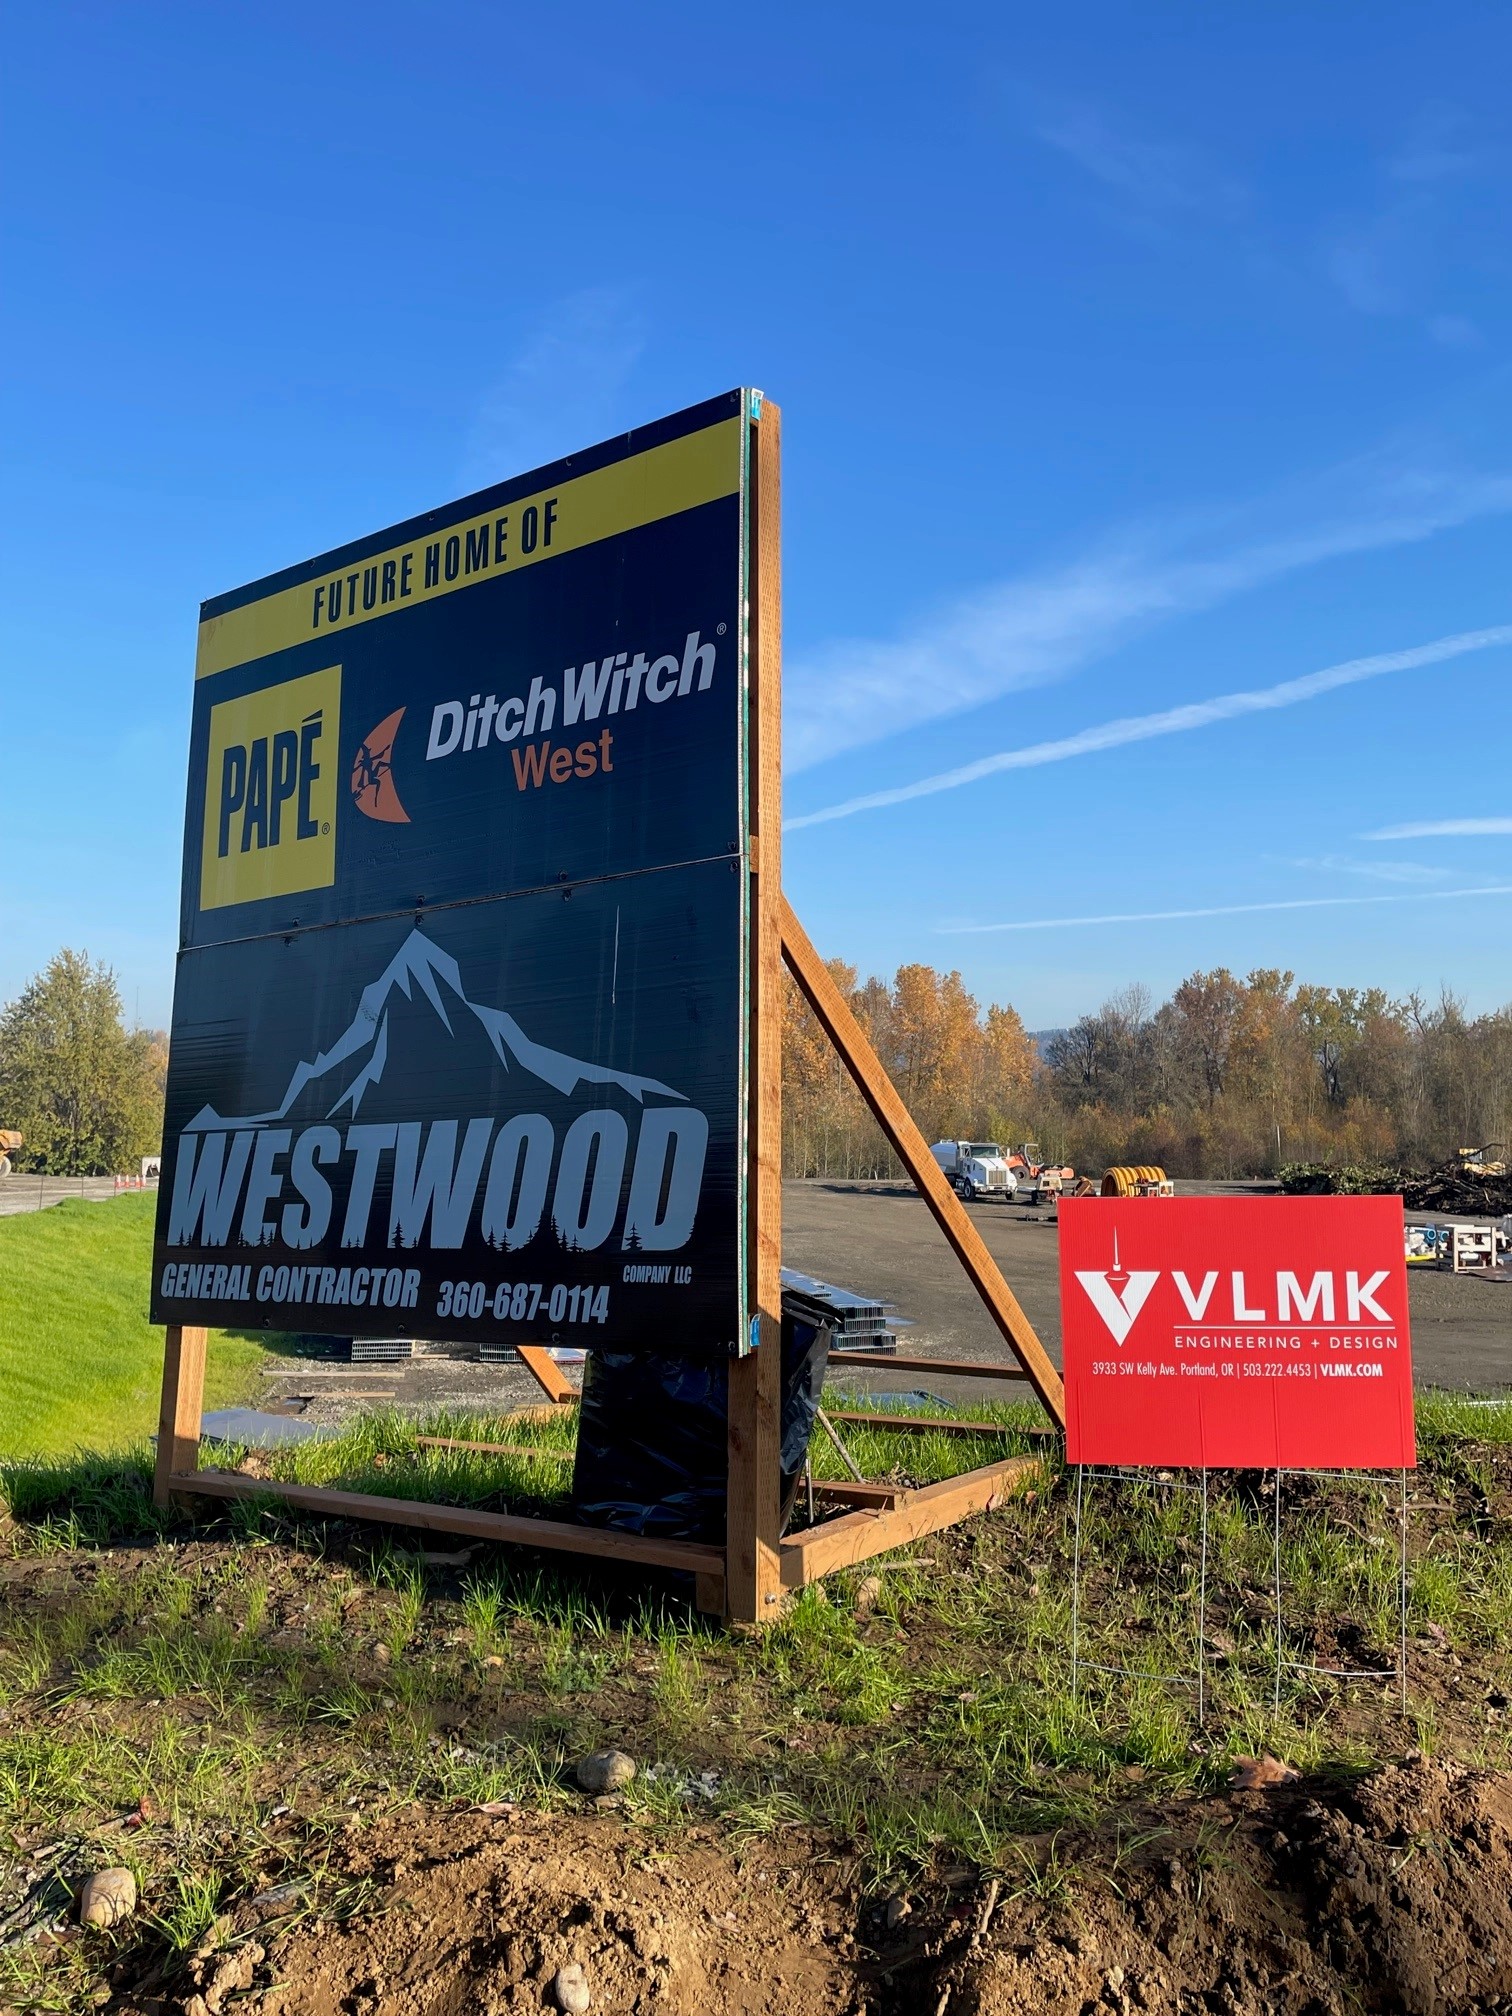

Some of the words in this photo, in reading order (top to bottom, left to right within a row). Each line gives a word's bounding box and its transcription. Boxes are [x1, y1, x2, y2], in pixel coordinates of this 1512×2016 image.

[312, 552, 413, 628] FUTURE
[424, 516, 508, 589] HOME
[521, 498, 559, 556] OF
[426, 675, 557, 761] Ditch
[563, 631, 717, 727] Witch
[218, 708, 323, 858] PAPÉ
[511, 728, 614, 792] West
[166, 1106, 710, 1253] WESTWOOD
[161, 1262, 252, 1302] GENERAL
[256, 1265, 421, 1308] CONTRACTOR
[622, 1264, 669, 1285] COMPANY
[673, 1265, 692, 1285] LLC
[1171, 1270, 1394, 1322] VLMK
[436, 1281, 611, 1325] 360-687-0114
[1174, 1335, 1302, 1349] ENGINEERING
[1329, 1335, 1398, 1350] DESIGN
[1092, 1361, 1117, 1376] 3933
[1119, 1361, 1134, 1376] SW
[1137, 1361, 1157, 1379] Kelly
[1159, 1362, 1178, 1377] Ave.
[1180, 1362, 1219, 1379] Portland,
[1221, 1363, 1234, 1377] OR
[1243, 1362, 1312, 1377] 503.222.4453
[1320, 1362, 1384, 1377] VLMK.COM
